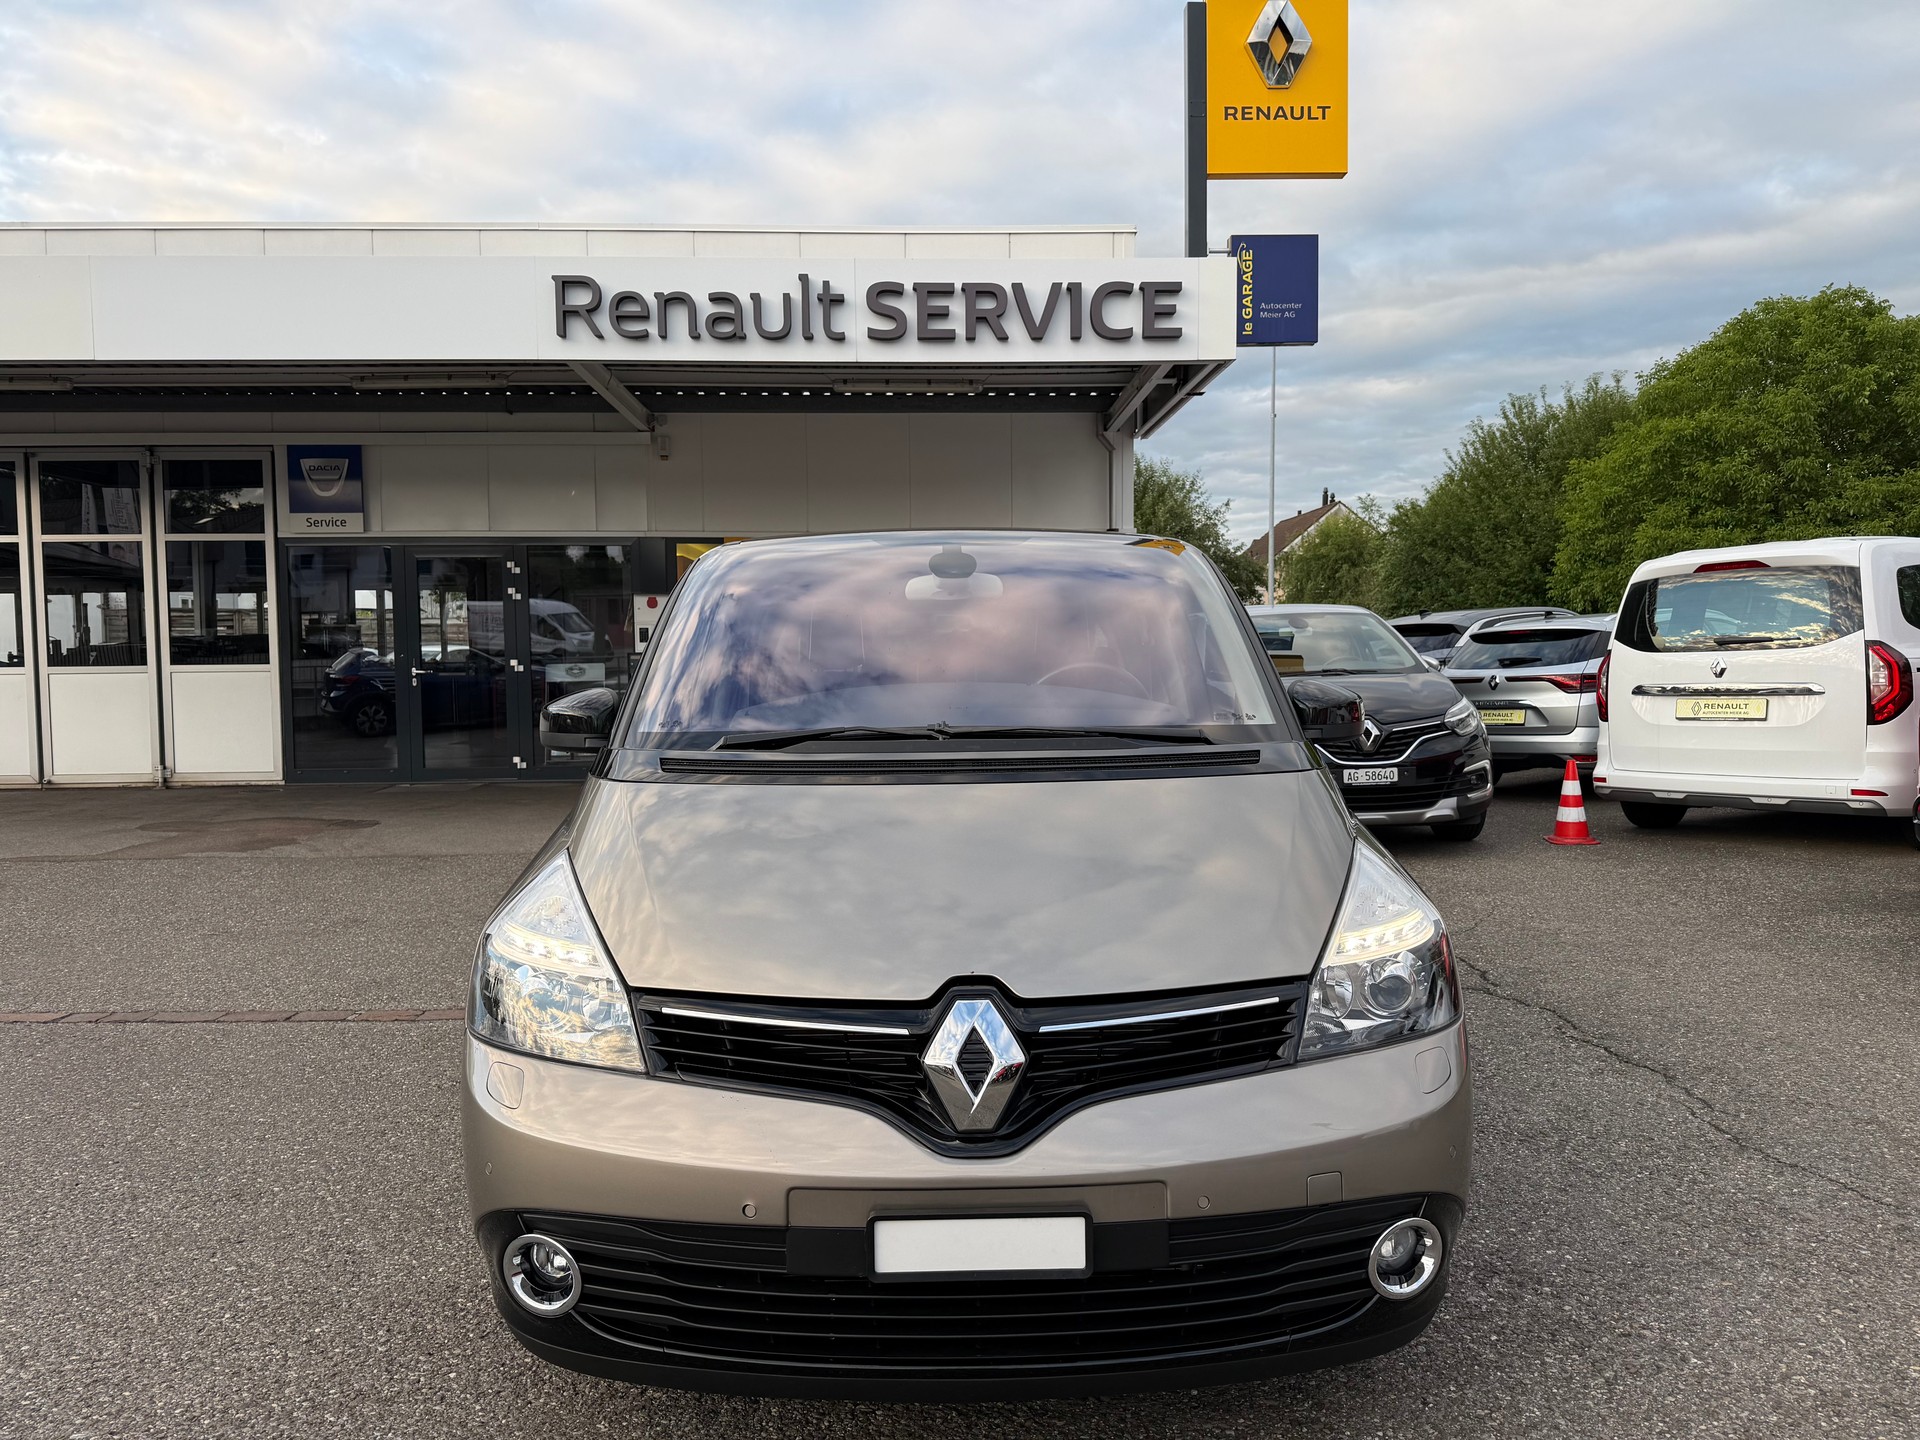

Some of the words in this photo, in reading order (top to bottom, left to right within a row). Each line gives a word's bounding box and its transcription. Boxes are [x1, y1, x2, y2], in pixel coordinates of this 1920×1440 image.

[1223, 105, 1331, 121] RENAULT
[1242, 249, 1253, 319] GARAGE
[551, 273, 846, 341] Renault
[865, 281, 1182, 341] SERVICE
[1242, 322, 1253, 335] le
[306, 517, 347, 527] Service
